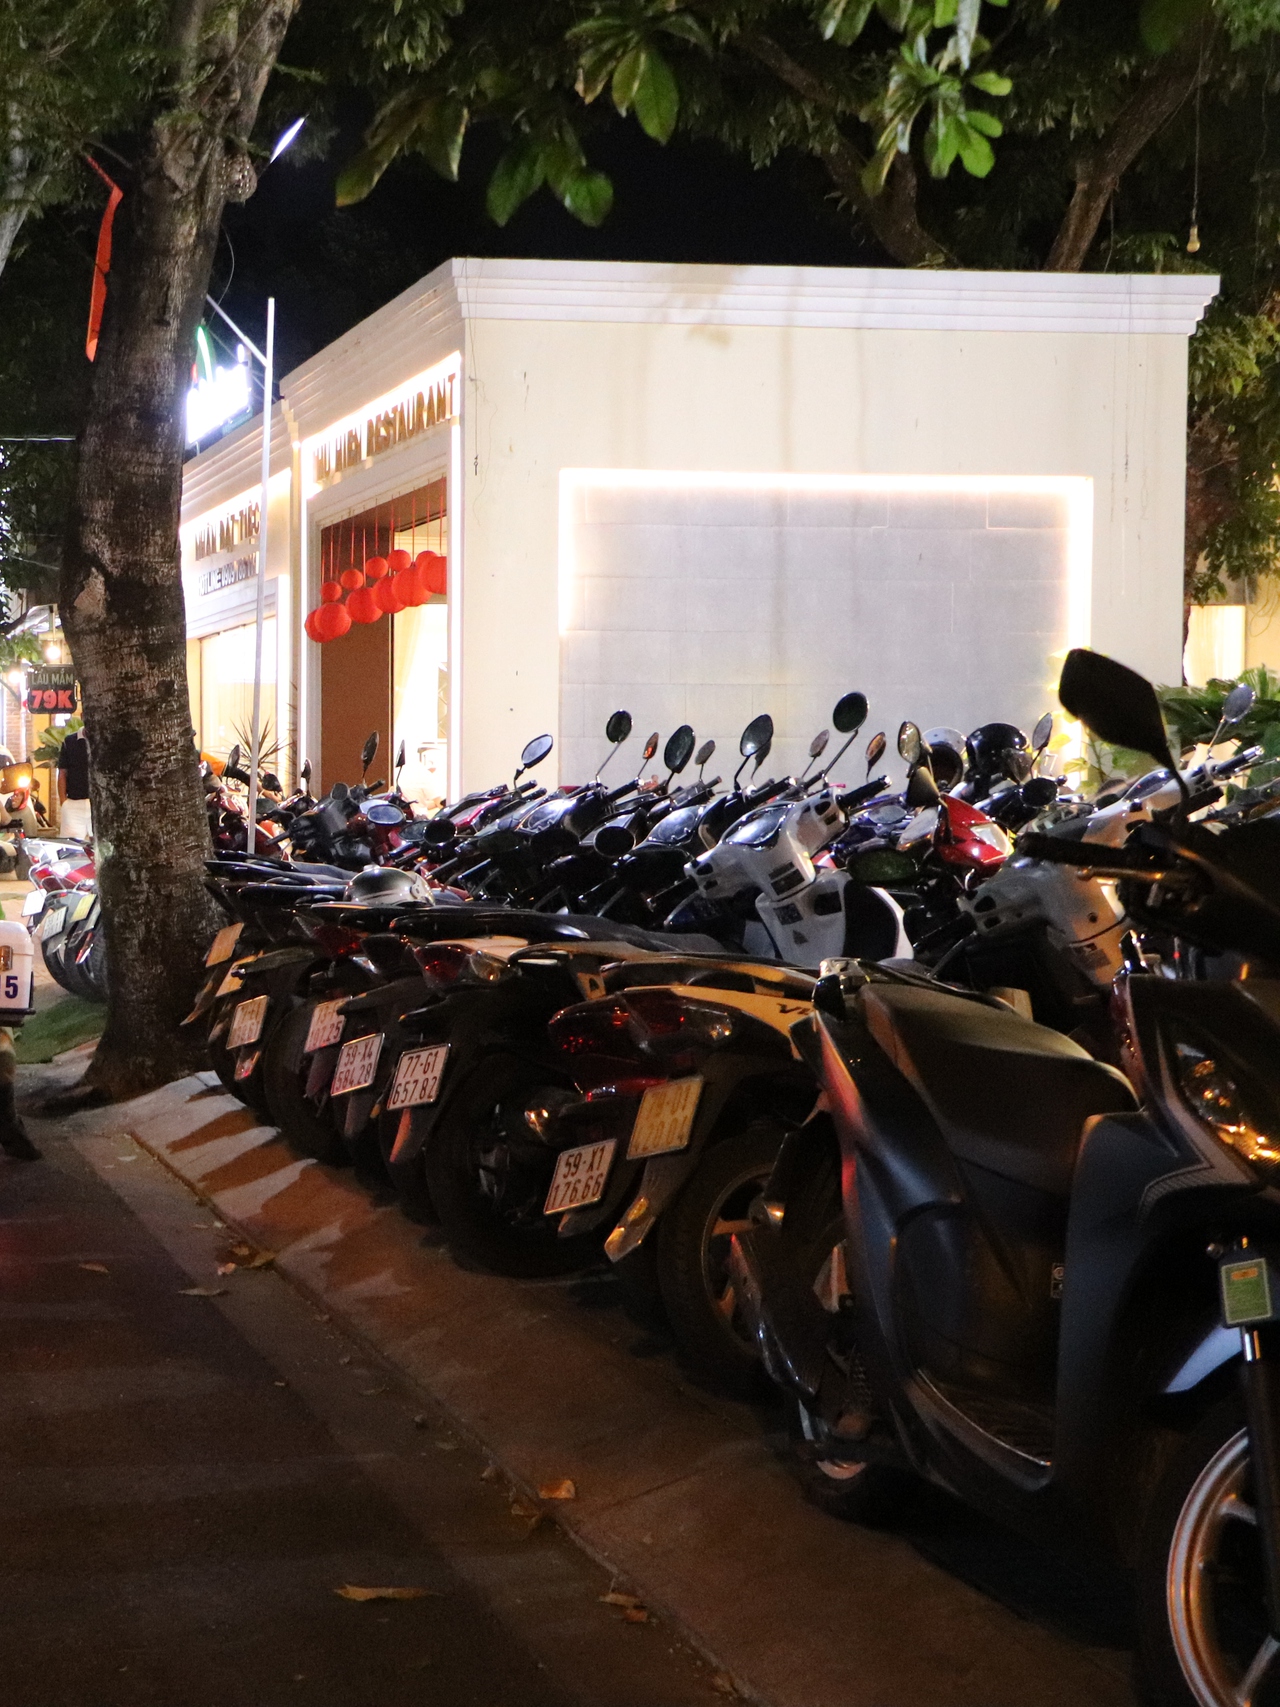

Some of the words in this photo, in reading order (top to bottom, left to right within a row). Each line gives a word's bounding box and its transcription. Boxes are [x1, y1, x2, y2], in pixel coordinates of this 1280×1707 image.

[367, 373, 456, 457] RESTAURANT
[31, 689, 73, 709] 79K
[344, 1040, 375, 1067] 59-X4
[403, 1050, 439, 1078] 77-G1
[335, 1062, 373, 1091] 584.28
[392, 1076, 438, 1105] 657.82
[563, 1145, 605, 1179] 59-X1
[551, 1173, 604, 1208] 176.66
